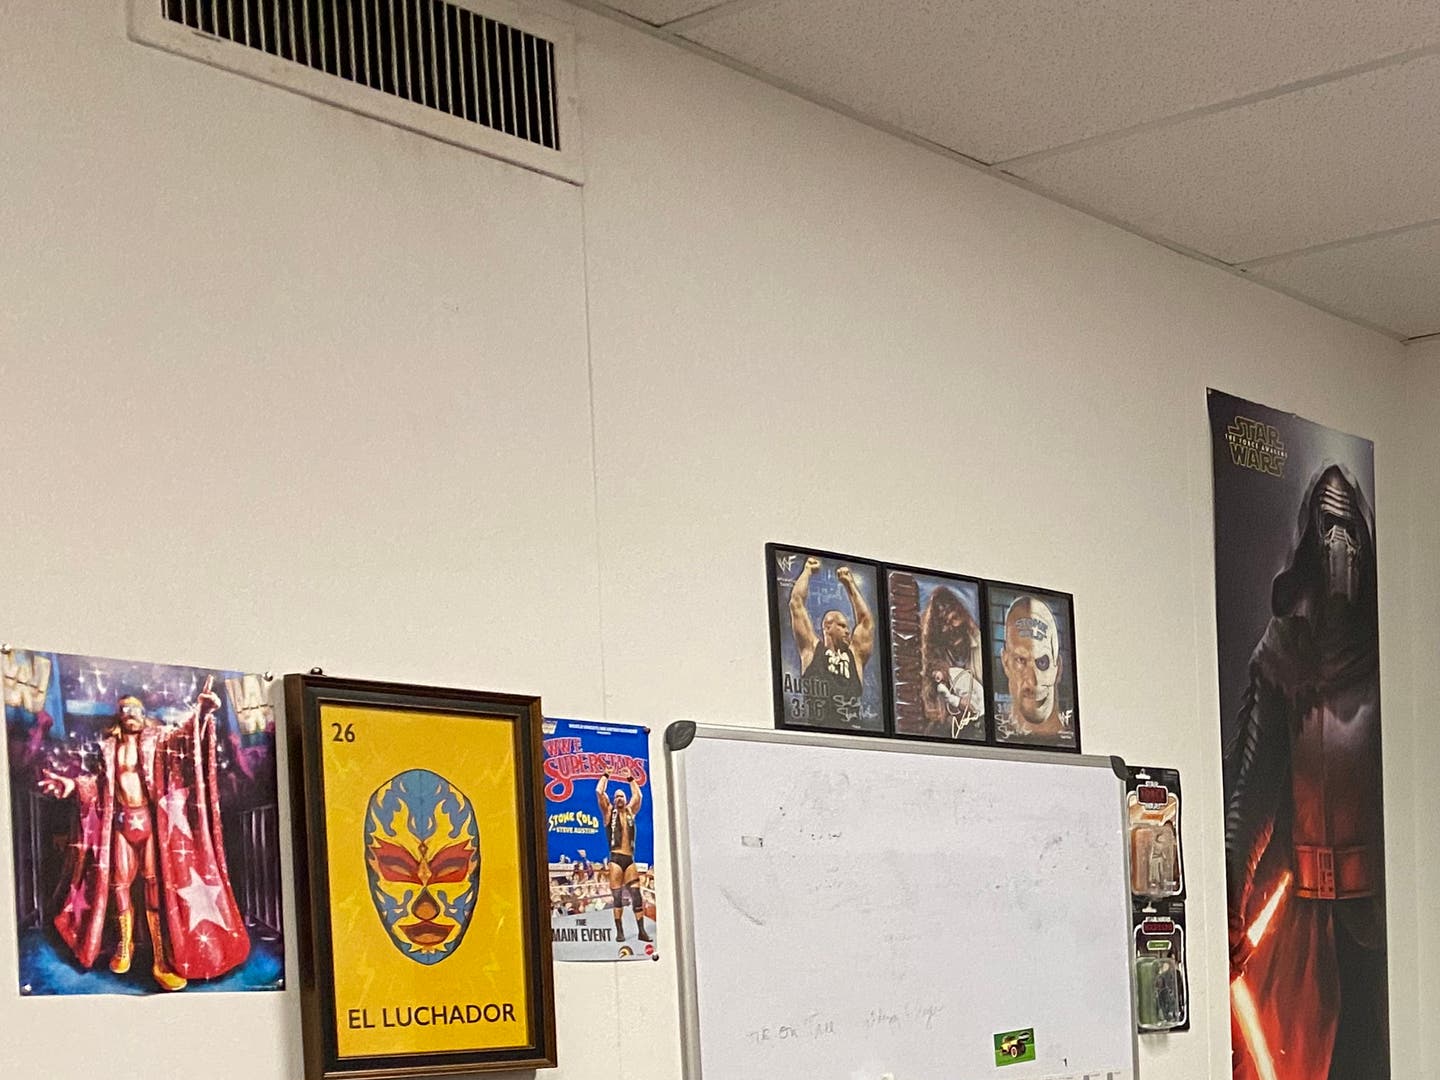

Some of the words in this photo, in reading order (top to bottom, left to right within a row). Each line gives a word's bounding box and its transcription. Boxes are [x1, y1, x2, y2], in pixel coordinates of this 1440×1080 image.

[1228, 415, 1285, 450] STAR
[1230, 441, 1286, 477] WARS
[784, 673, 830, 697] Austin
[791, 698, 826, 720] 3:16
[331, 723, 356, 743] 26
[543, 737, 583, 756] WWE
[548, 811, 575, 832] STONE
[552, 928, 578, 942] MAIN
[581, 928, 612, 942] EVENT
[348, 1008, 376, 1029] EL
[382, 1003, 517, 1028] LUCHADOR
